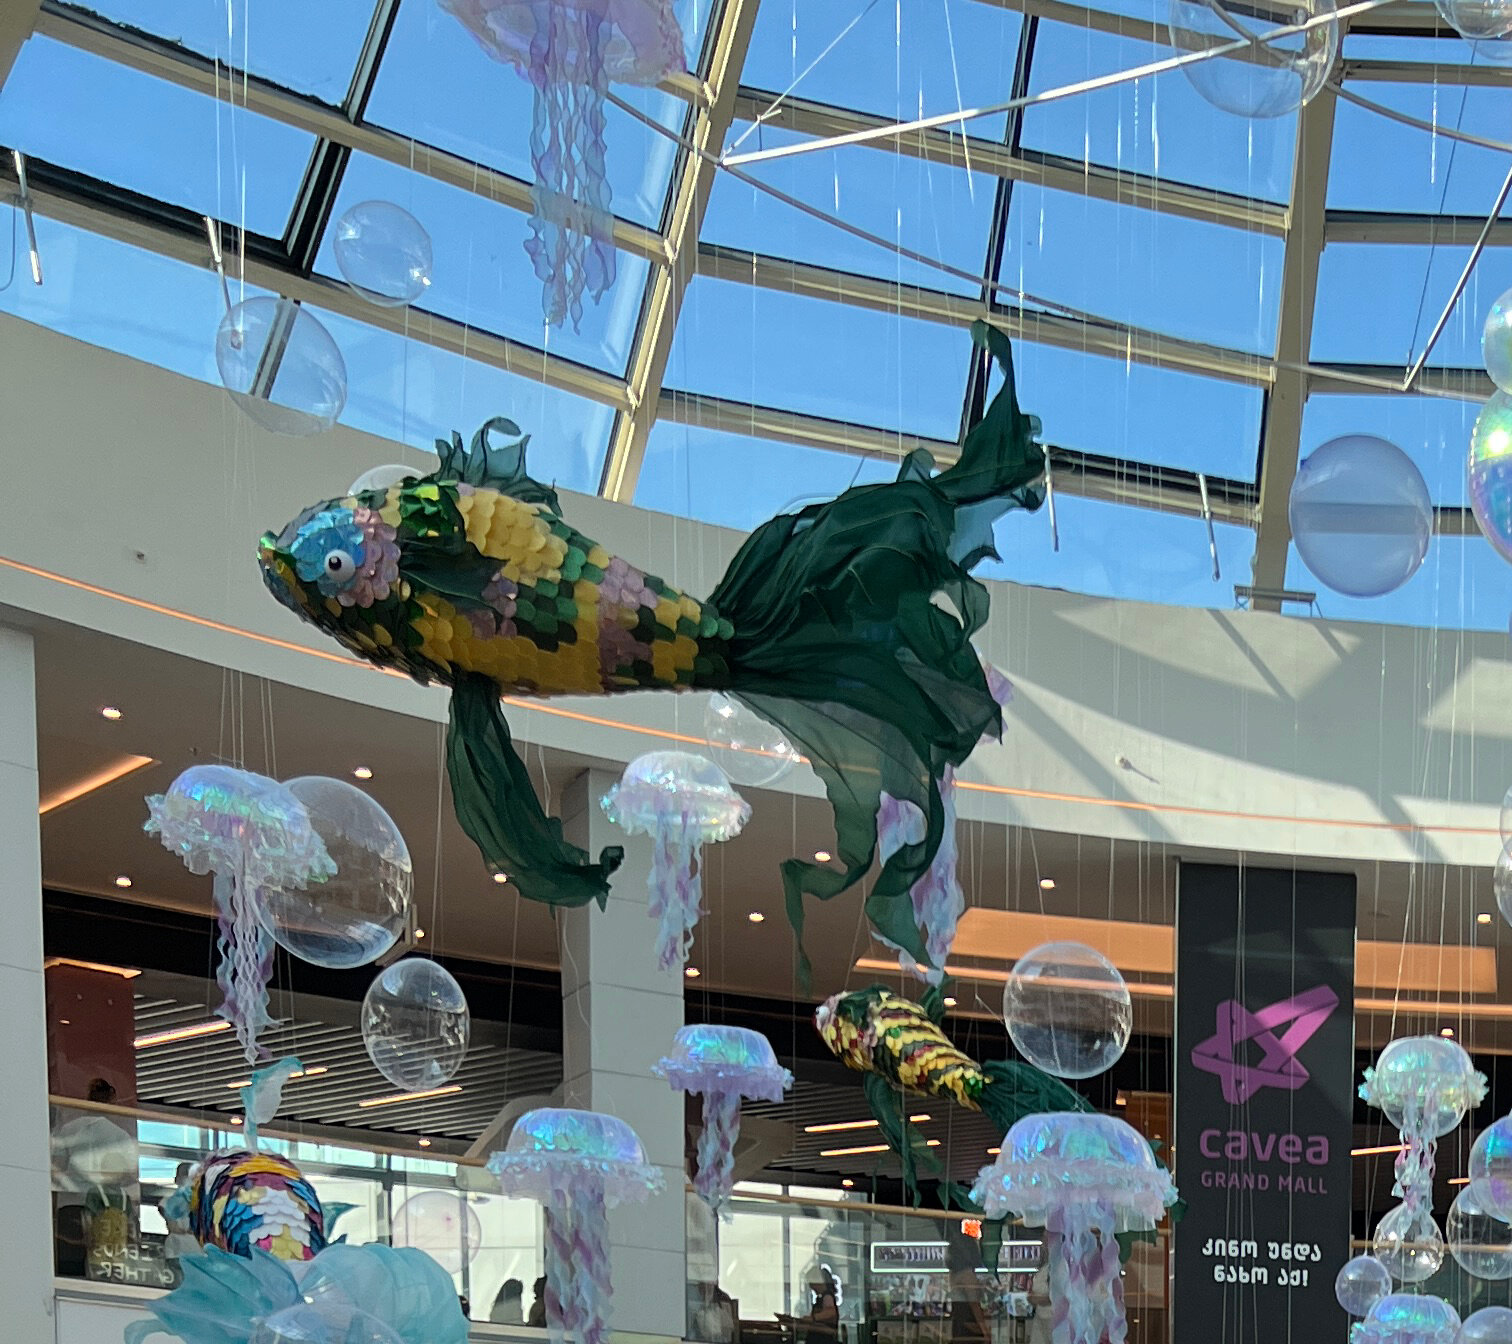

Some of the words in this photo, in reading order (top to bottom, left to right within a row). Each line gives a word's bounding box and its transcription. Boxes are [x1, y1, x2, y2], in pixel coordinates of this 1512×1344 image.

[1199, 1128, 1330, 1165] cavea
[1201, 1171, 1269, 1191] GRAND
[1278, 1174, 1328, 1194] MALL
[1202, 1238, 1258, 1259] კინო
[1268, 1241, 1321, 1262] უნდა
[1213, 1265, 1268, 1285] ნახო
[1277, 1268, 1309, 1287] აქ!
